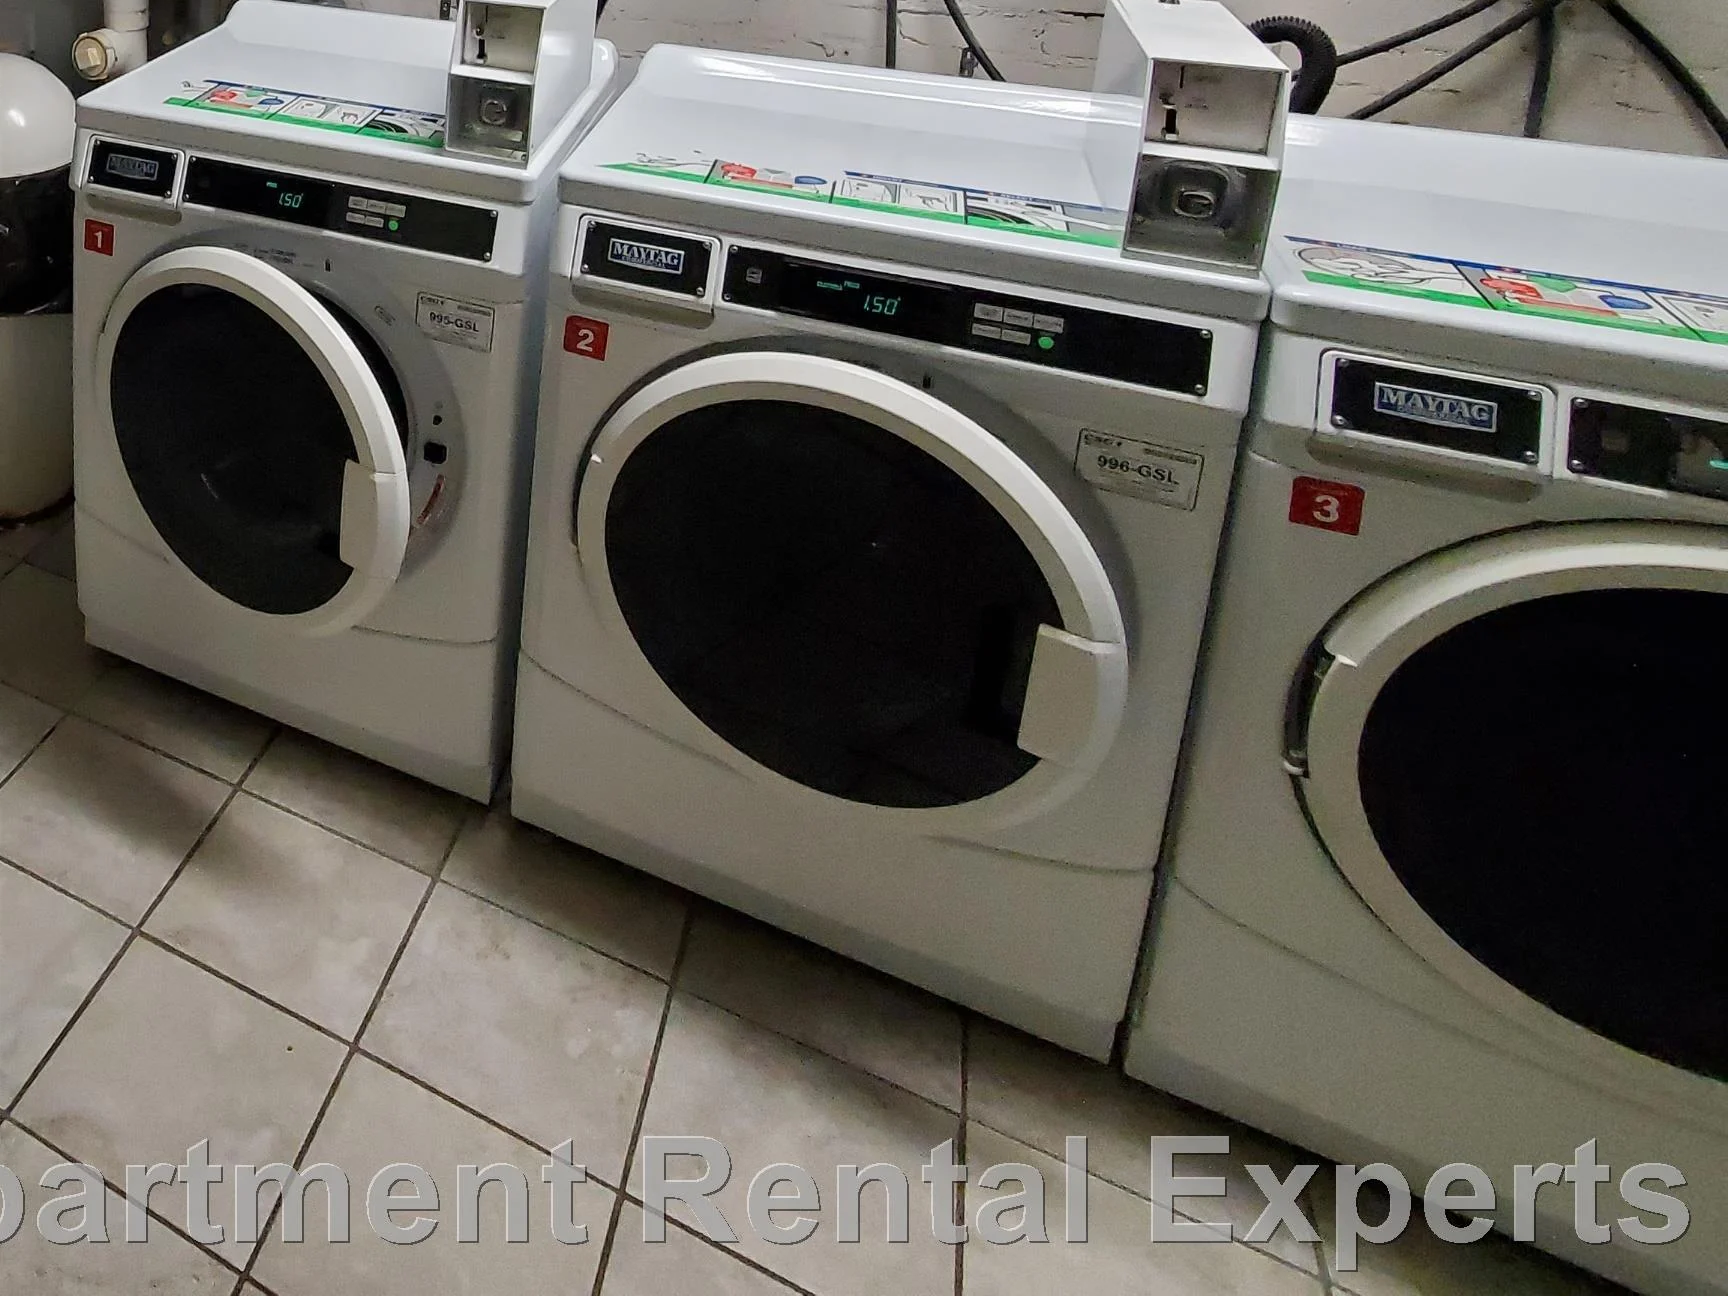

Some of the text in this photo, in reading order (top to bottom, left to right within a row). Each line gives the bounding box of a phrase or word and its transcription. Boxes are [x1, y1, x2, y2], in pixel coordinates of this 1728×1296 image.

[94, 231, 103, 249] 1
[613, 242, 679, 266] MAYTAG
[576, 329, 595, 352] 2
[1380, 386, 1490, 421] MAYTAG
[1097, 454, 1180, 485] 996-GSL
[1312, 494, 1340, 523] 3
